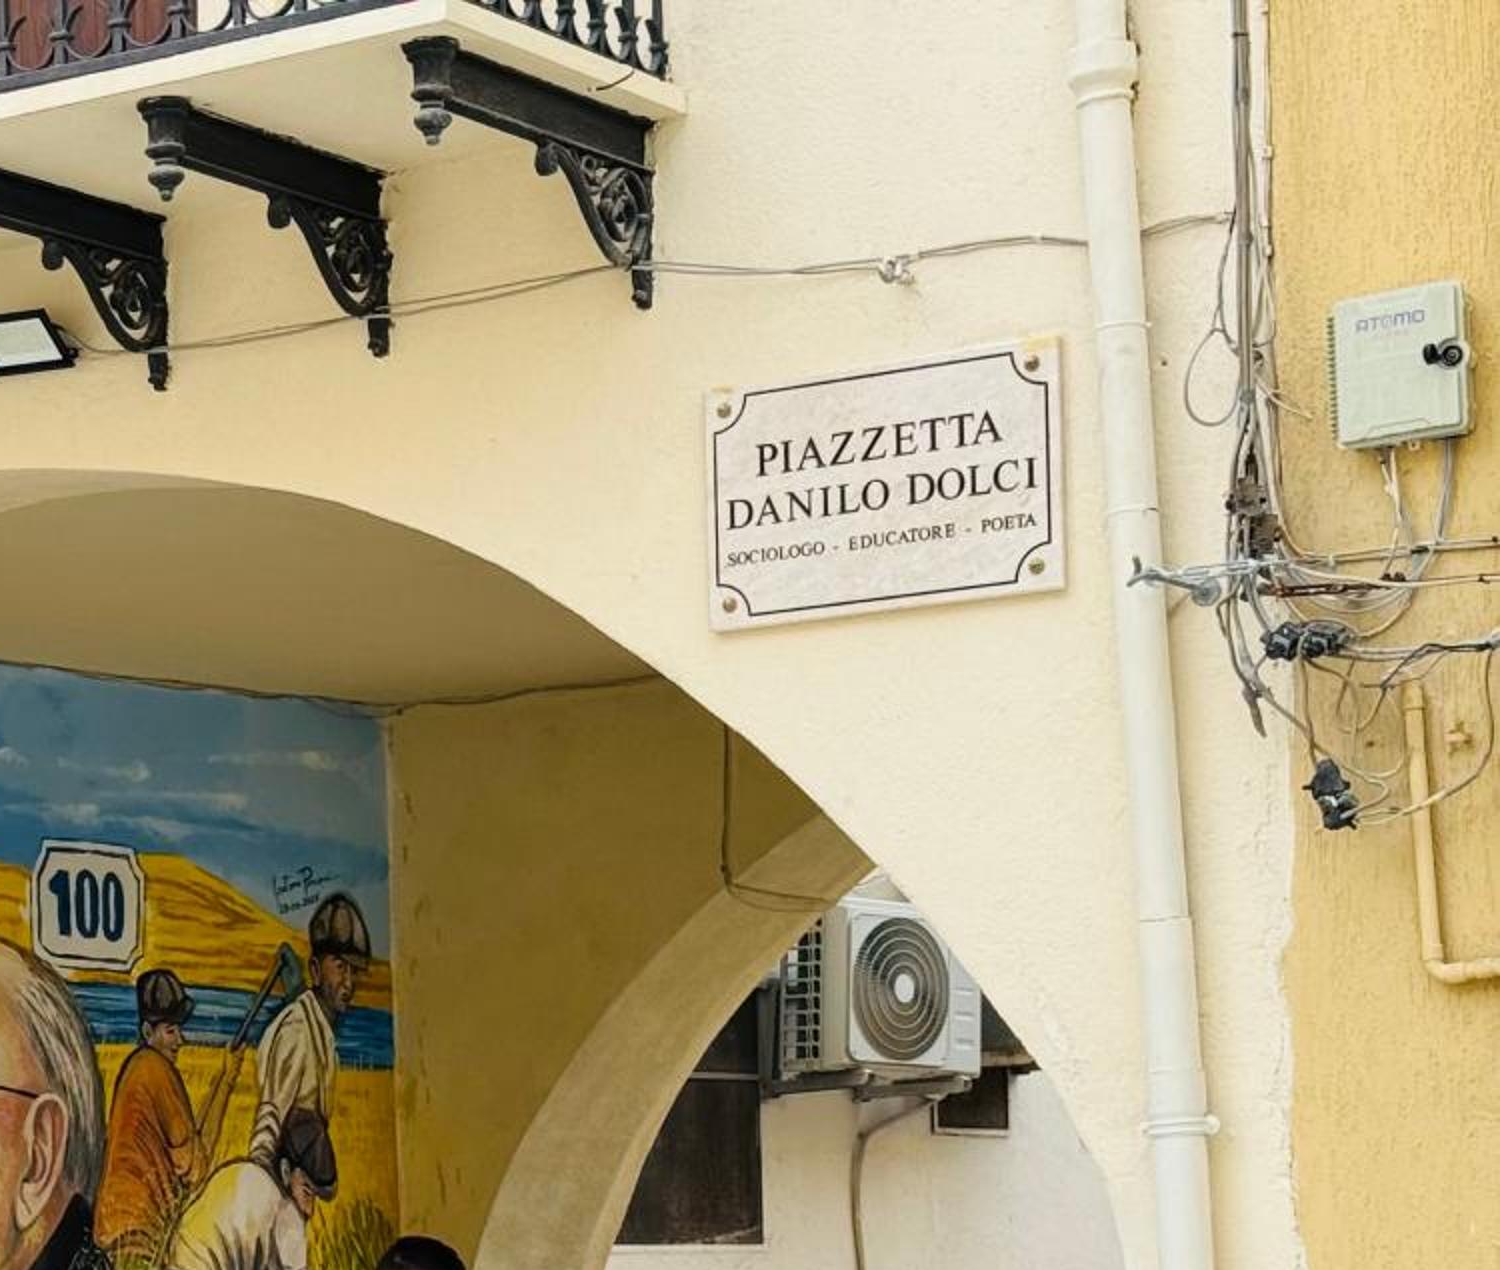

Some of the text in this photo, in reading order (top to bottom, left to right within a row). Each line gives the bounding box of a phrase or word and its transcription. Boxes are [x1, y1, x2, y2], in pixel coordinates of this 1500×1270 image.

[755, 410, 1003, 477] PIAZZETTA
[726, 457, 1038, 531] DANILO DOLCI
[725, 541, 825, 567] SOCIOLOGO
[849, 523, 955, 551] EDUCATORE
[980, 513, 1037, 533] POETA
[49, 869, 125, 942] 100
